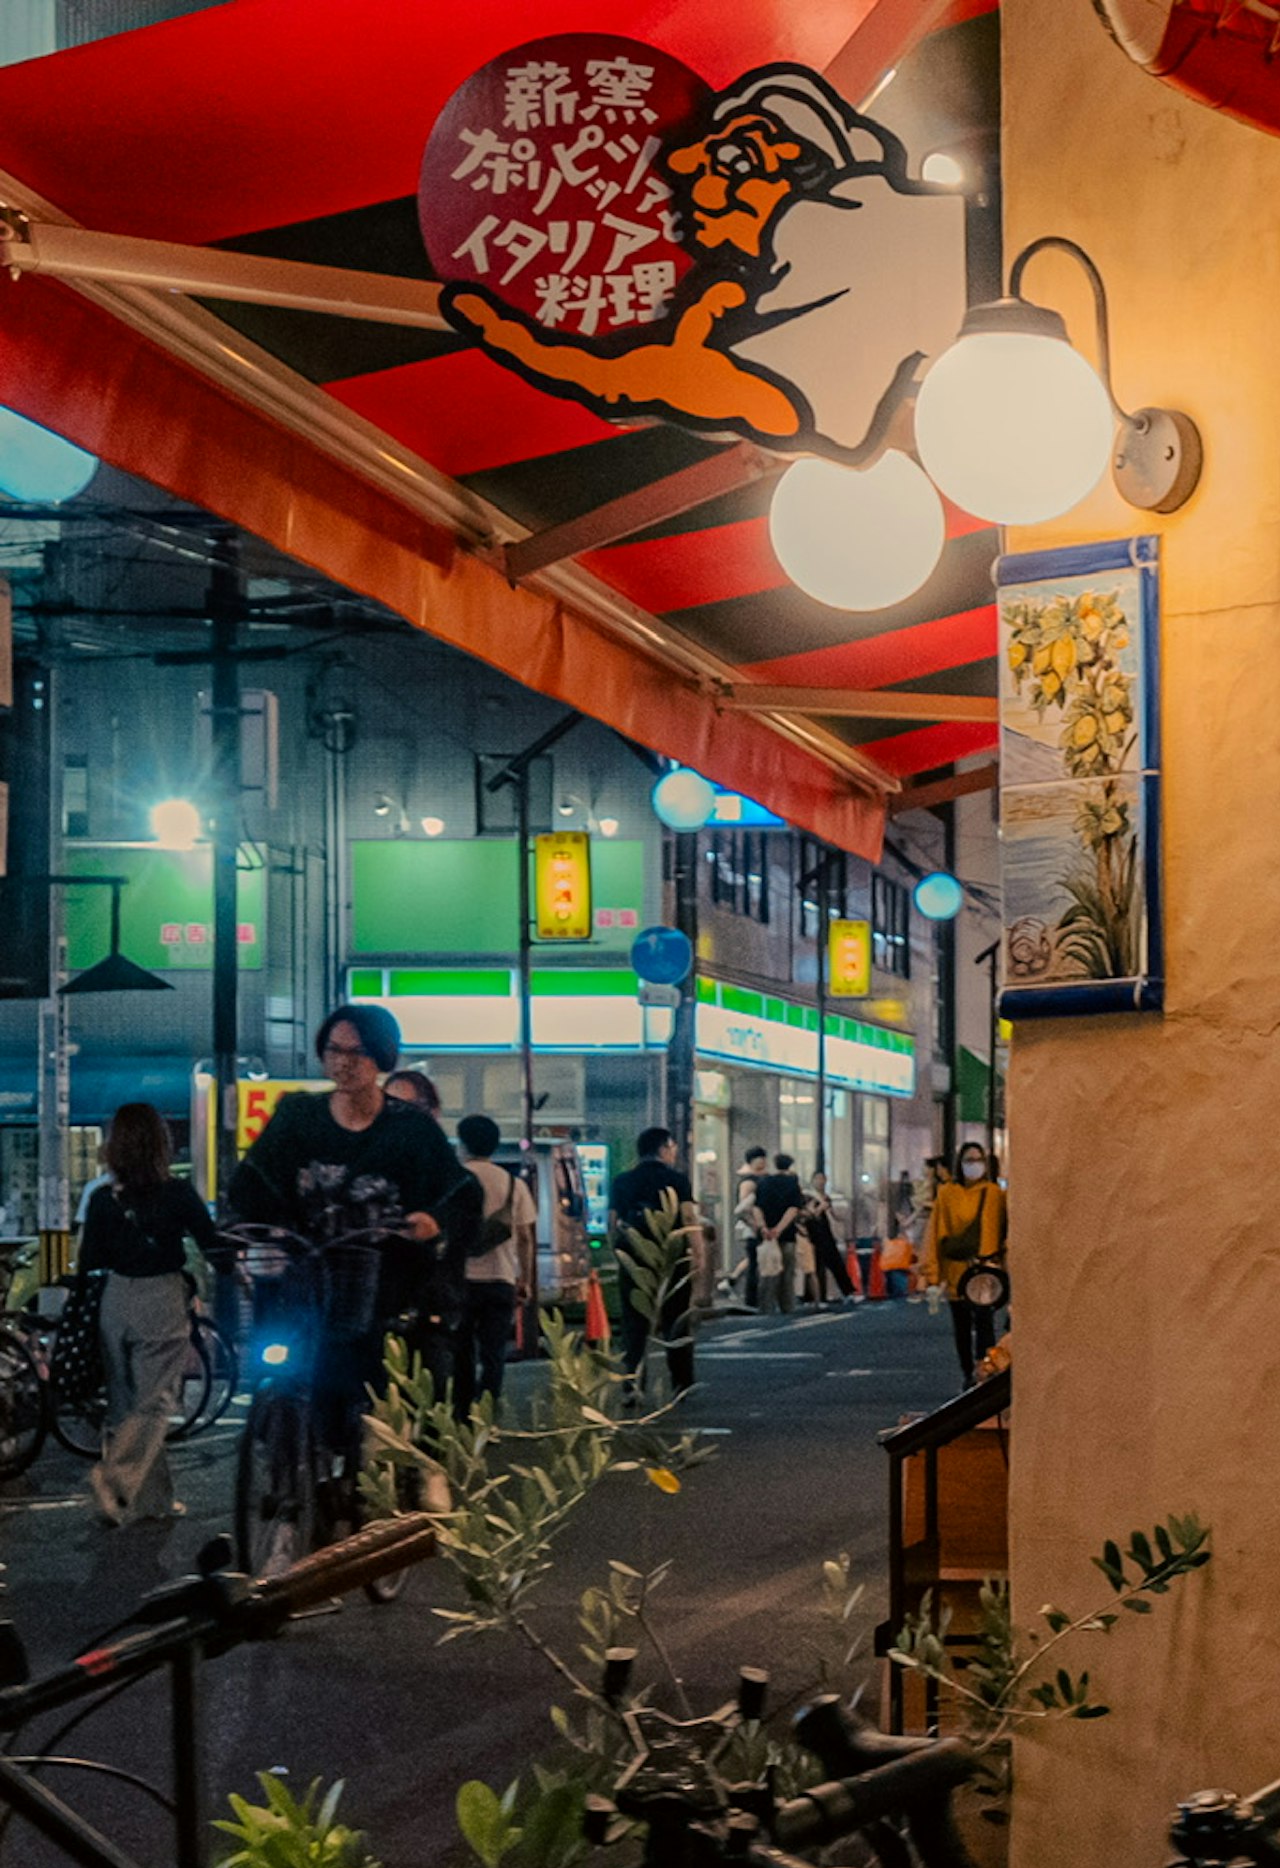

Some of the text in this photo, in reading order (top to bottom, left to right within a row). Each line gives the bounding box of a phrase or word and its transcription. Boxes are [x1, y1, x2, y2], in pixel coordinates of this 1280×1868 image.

[503, 56, 659, 132] 薪窯
[451, 212, 660, 286] イタリア
[534, 260, 676, 336] 料理
